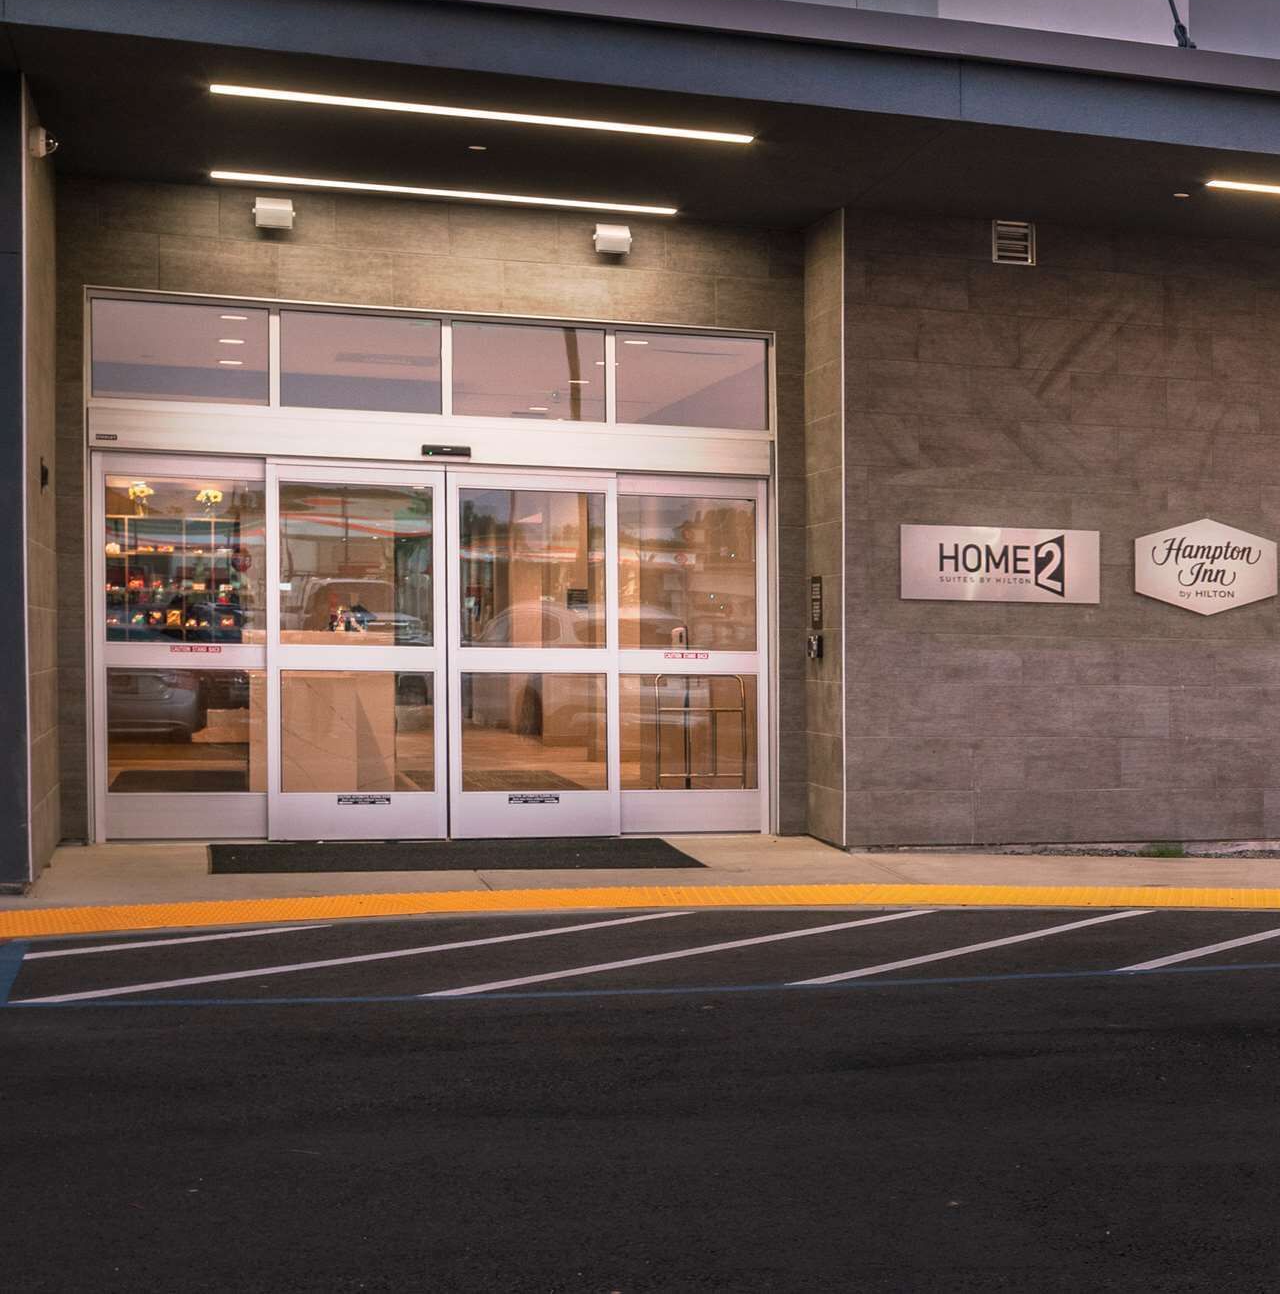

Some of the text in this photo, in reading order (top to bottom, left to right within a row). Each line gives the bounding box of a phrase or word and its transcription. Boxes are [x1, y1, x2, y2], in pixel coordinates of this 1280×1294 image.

[1151, 537, 1261, 565] Hampton
[1178, 562, 1236, 586] Inn
[1179, 590, 1235, 599] by HILTON
